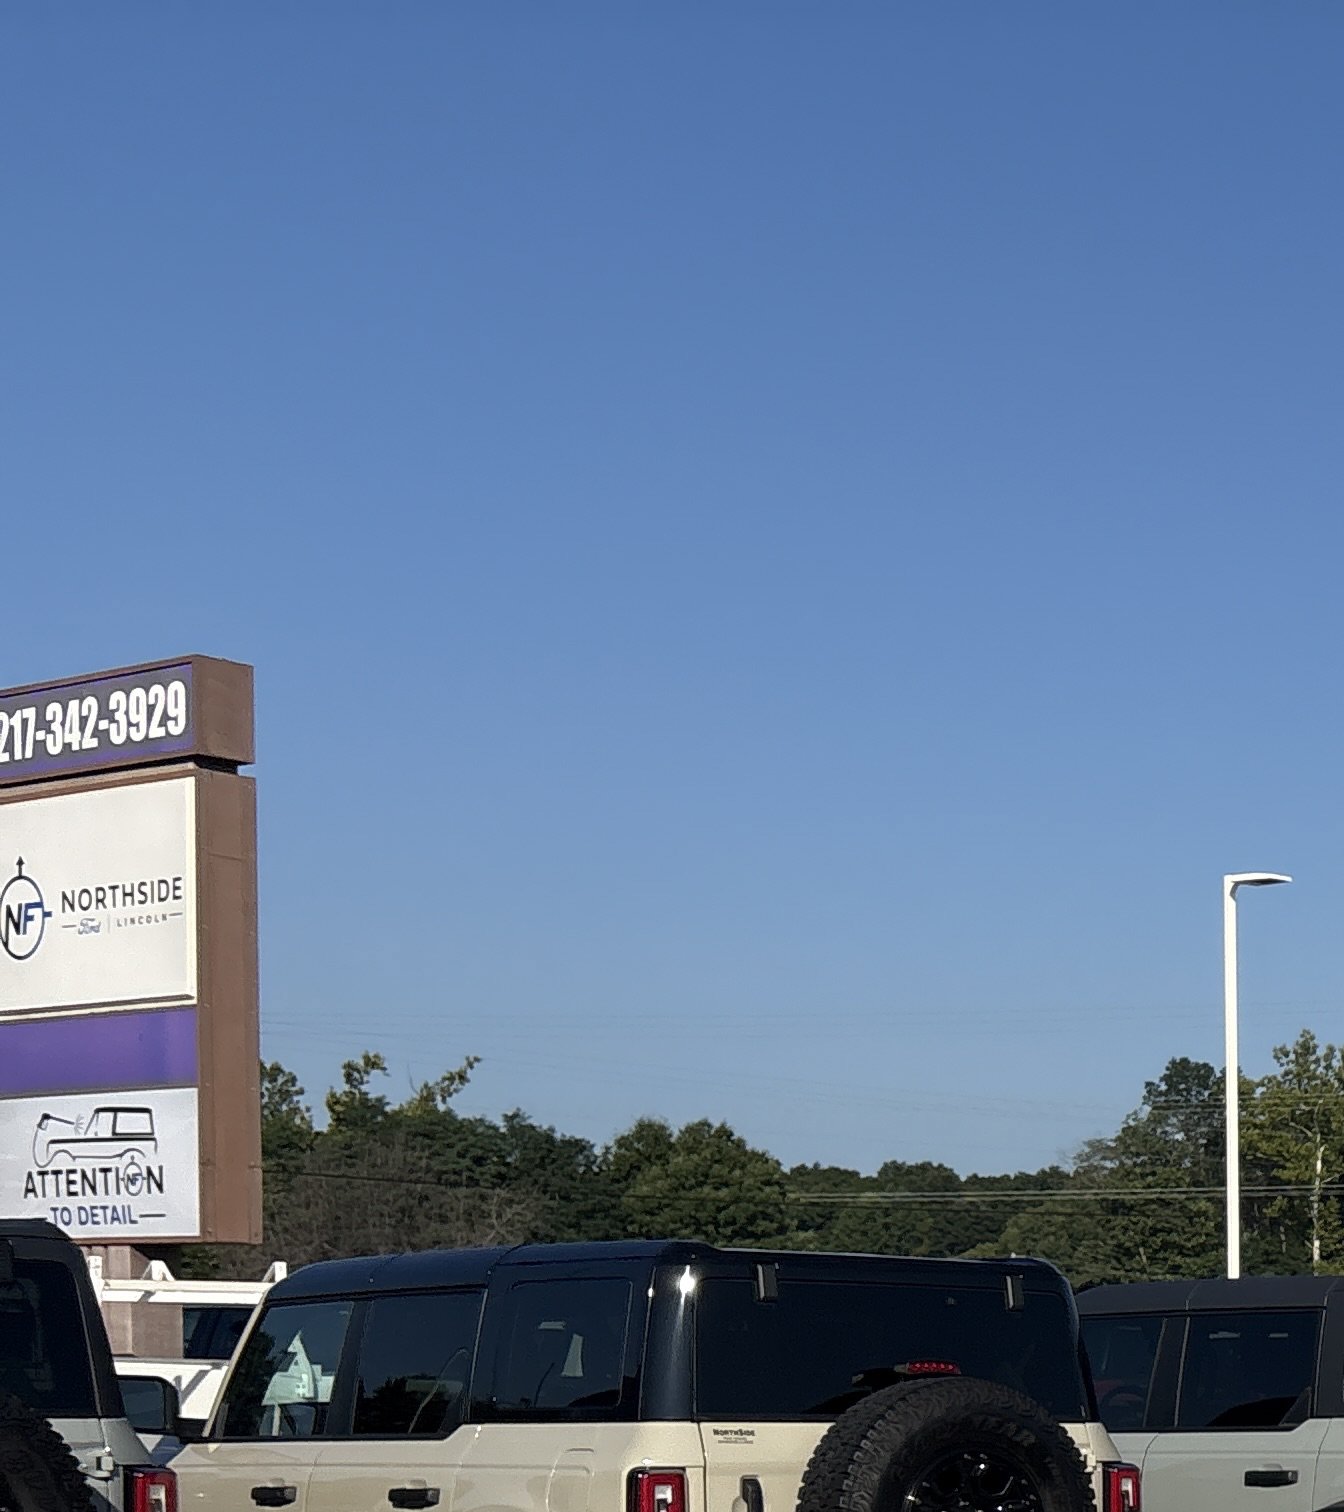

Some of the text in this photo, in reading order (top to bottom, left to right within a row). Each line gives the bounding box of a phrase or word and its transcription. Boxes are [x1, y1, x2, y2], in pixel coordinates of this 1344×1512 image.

[0, 681, 187, 763] 217-342-3929
[61, 876, 183, 914] NORTHSIDE
[77, 913, 168, 935] Ford LINCOLN
[23, 1163, 165, 1199] ATTENTION
[50, 1204, 139, 1226] TO DETAIL
